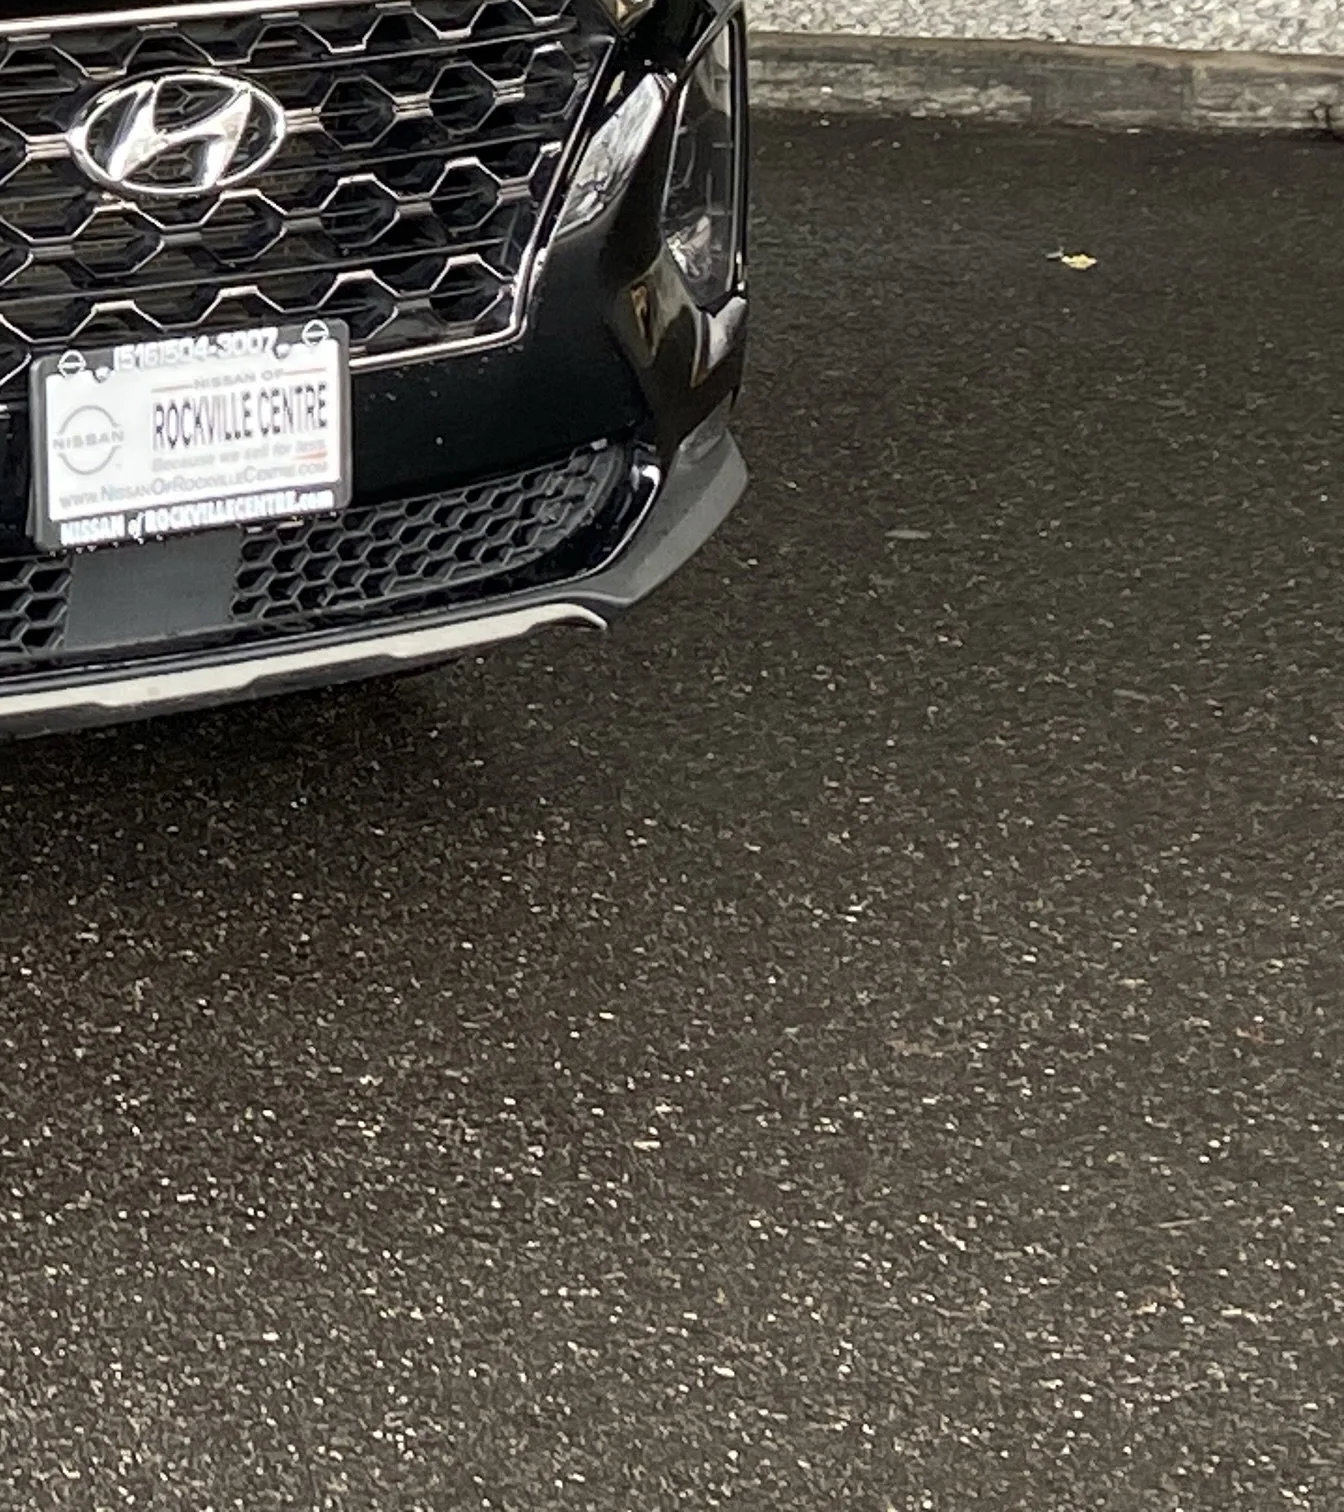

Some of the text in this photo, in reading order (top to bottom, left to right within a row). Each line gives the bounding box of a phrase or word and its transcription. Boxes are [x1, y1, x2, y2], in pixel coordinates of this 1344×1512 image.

[152, 381, 329, 450] ROCKVILLE CENTRE
[52, 430, 125, 451] NISSAN
[60, 513, 126, 546] NISSAN
